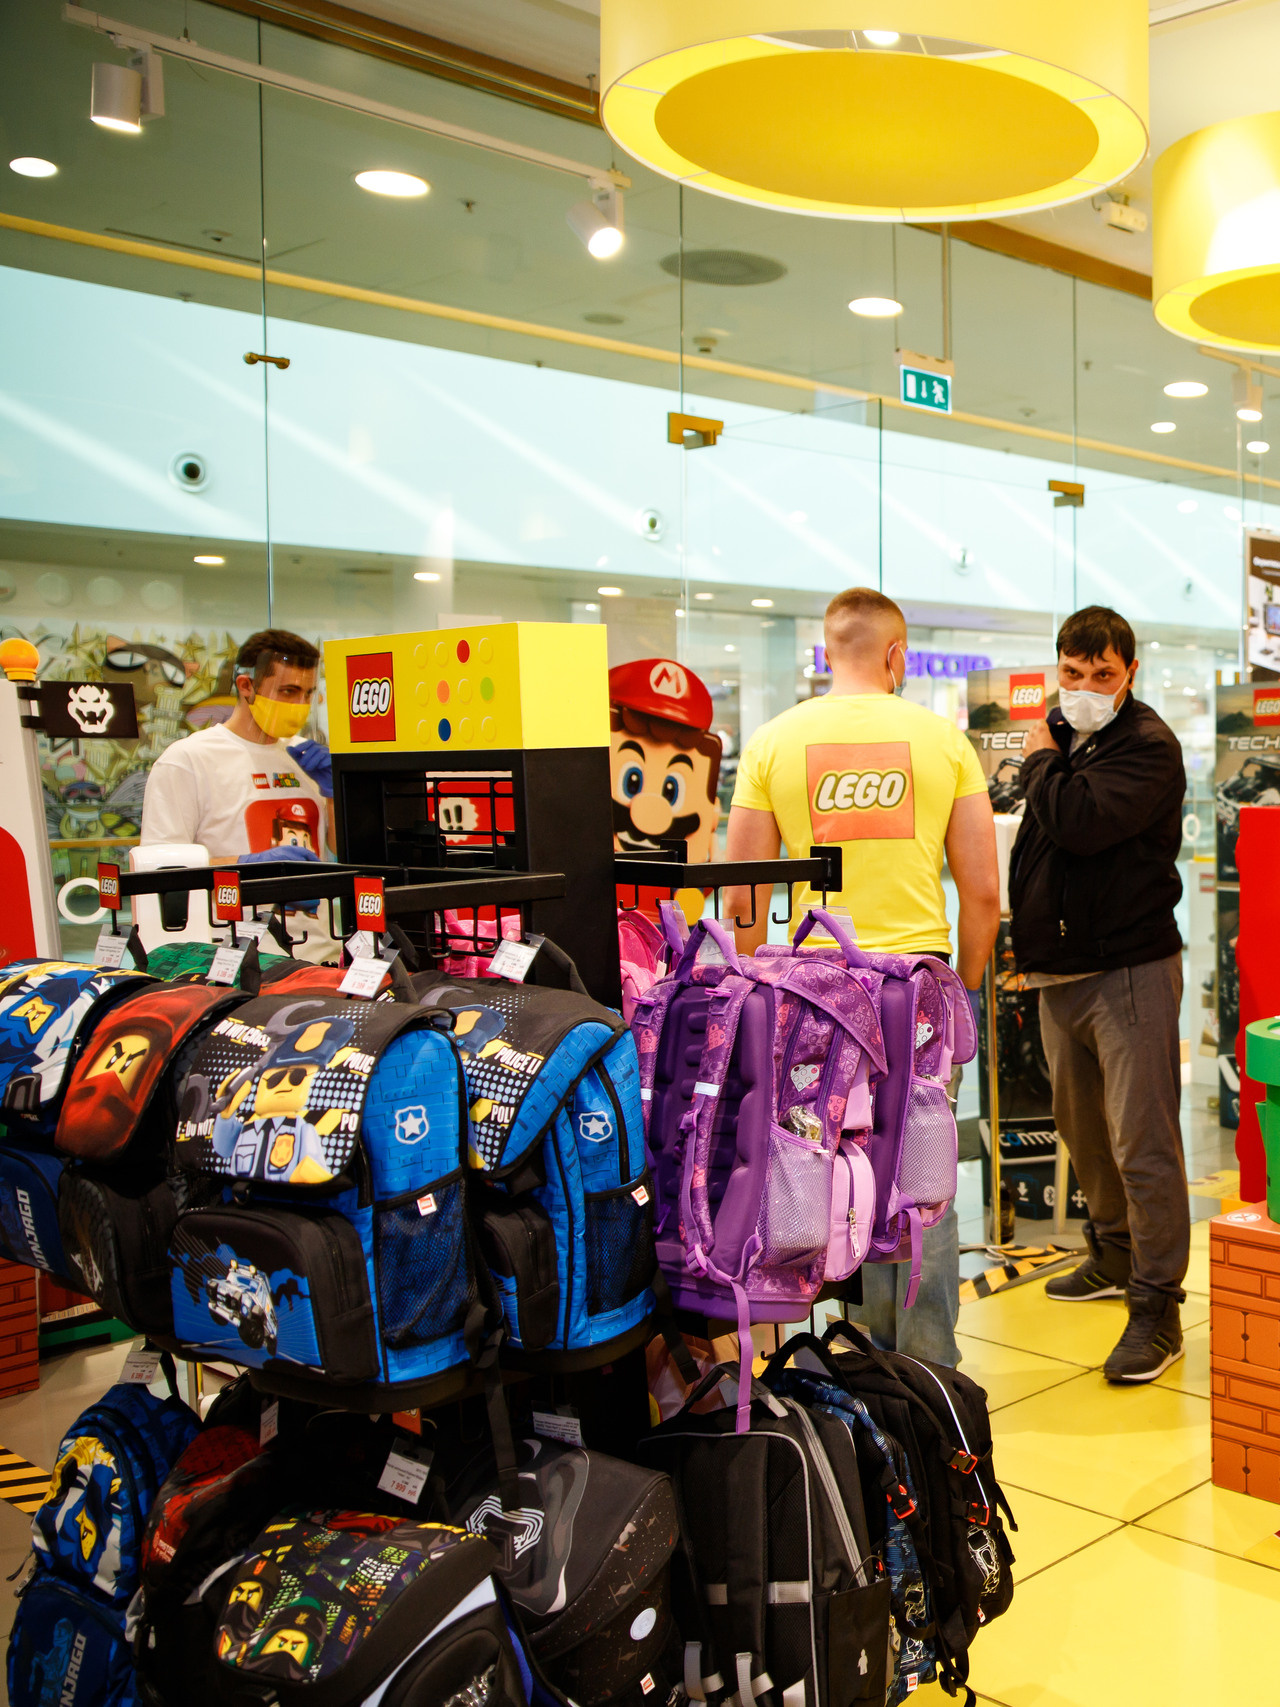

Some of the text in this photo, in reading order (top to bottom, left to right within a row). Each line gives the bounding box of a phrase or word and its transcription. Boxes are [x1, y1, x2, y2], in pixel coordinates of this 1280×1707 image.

[351, 680, 391, 715] LEGO
[1011, 686, 1043, 707] LEGO
[815, 771, 906, 812] LEGO
[101, 876, 118, 897] LEGO
[218, 885, 239, 907] LEGO
[358, 893, 382, 916] LEGO
[494, 1046, 531, 1071] POLICE
[340, 1113, 359, 1132] PO
